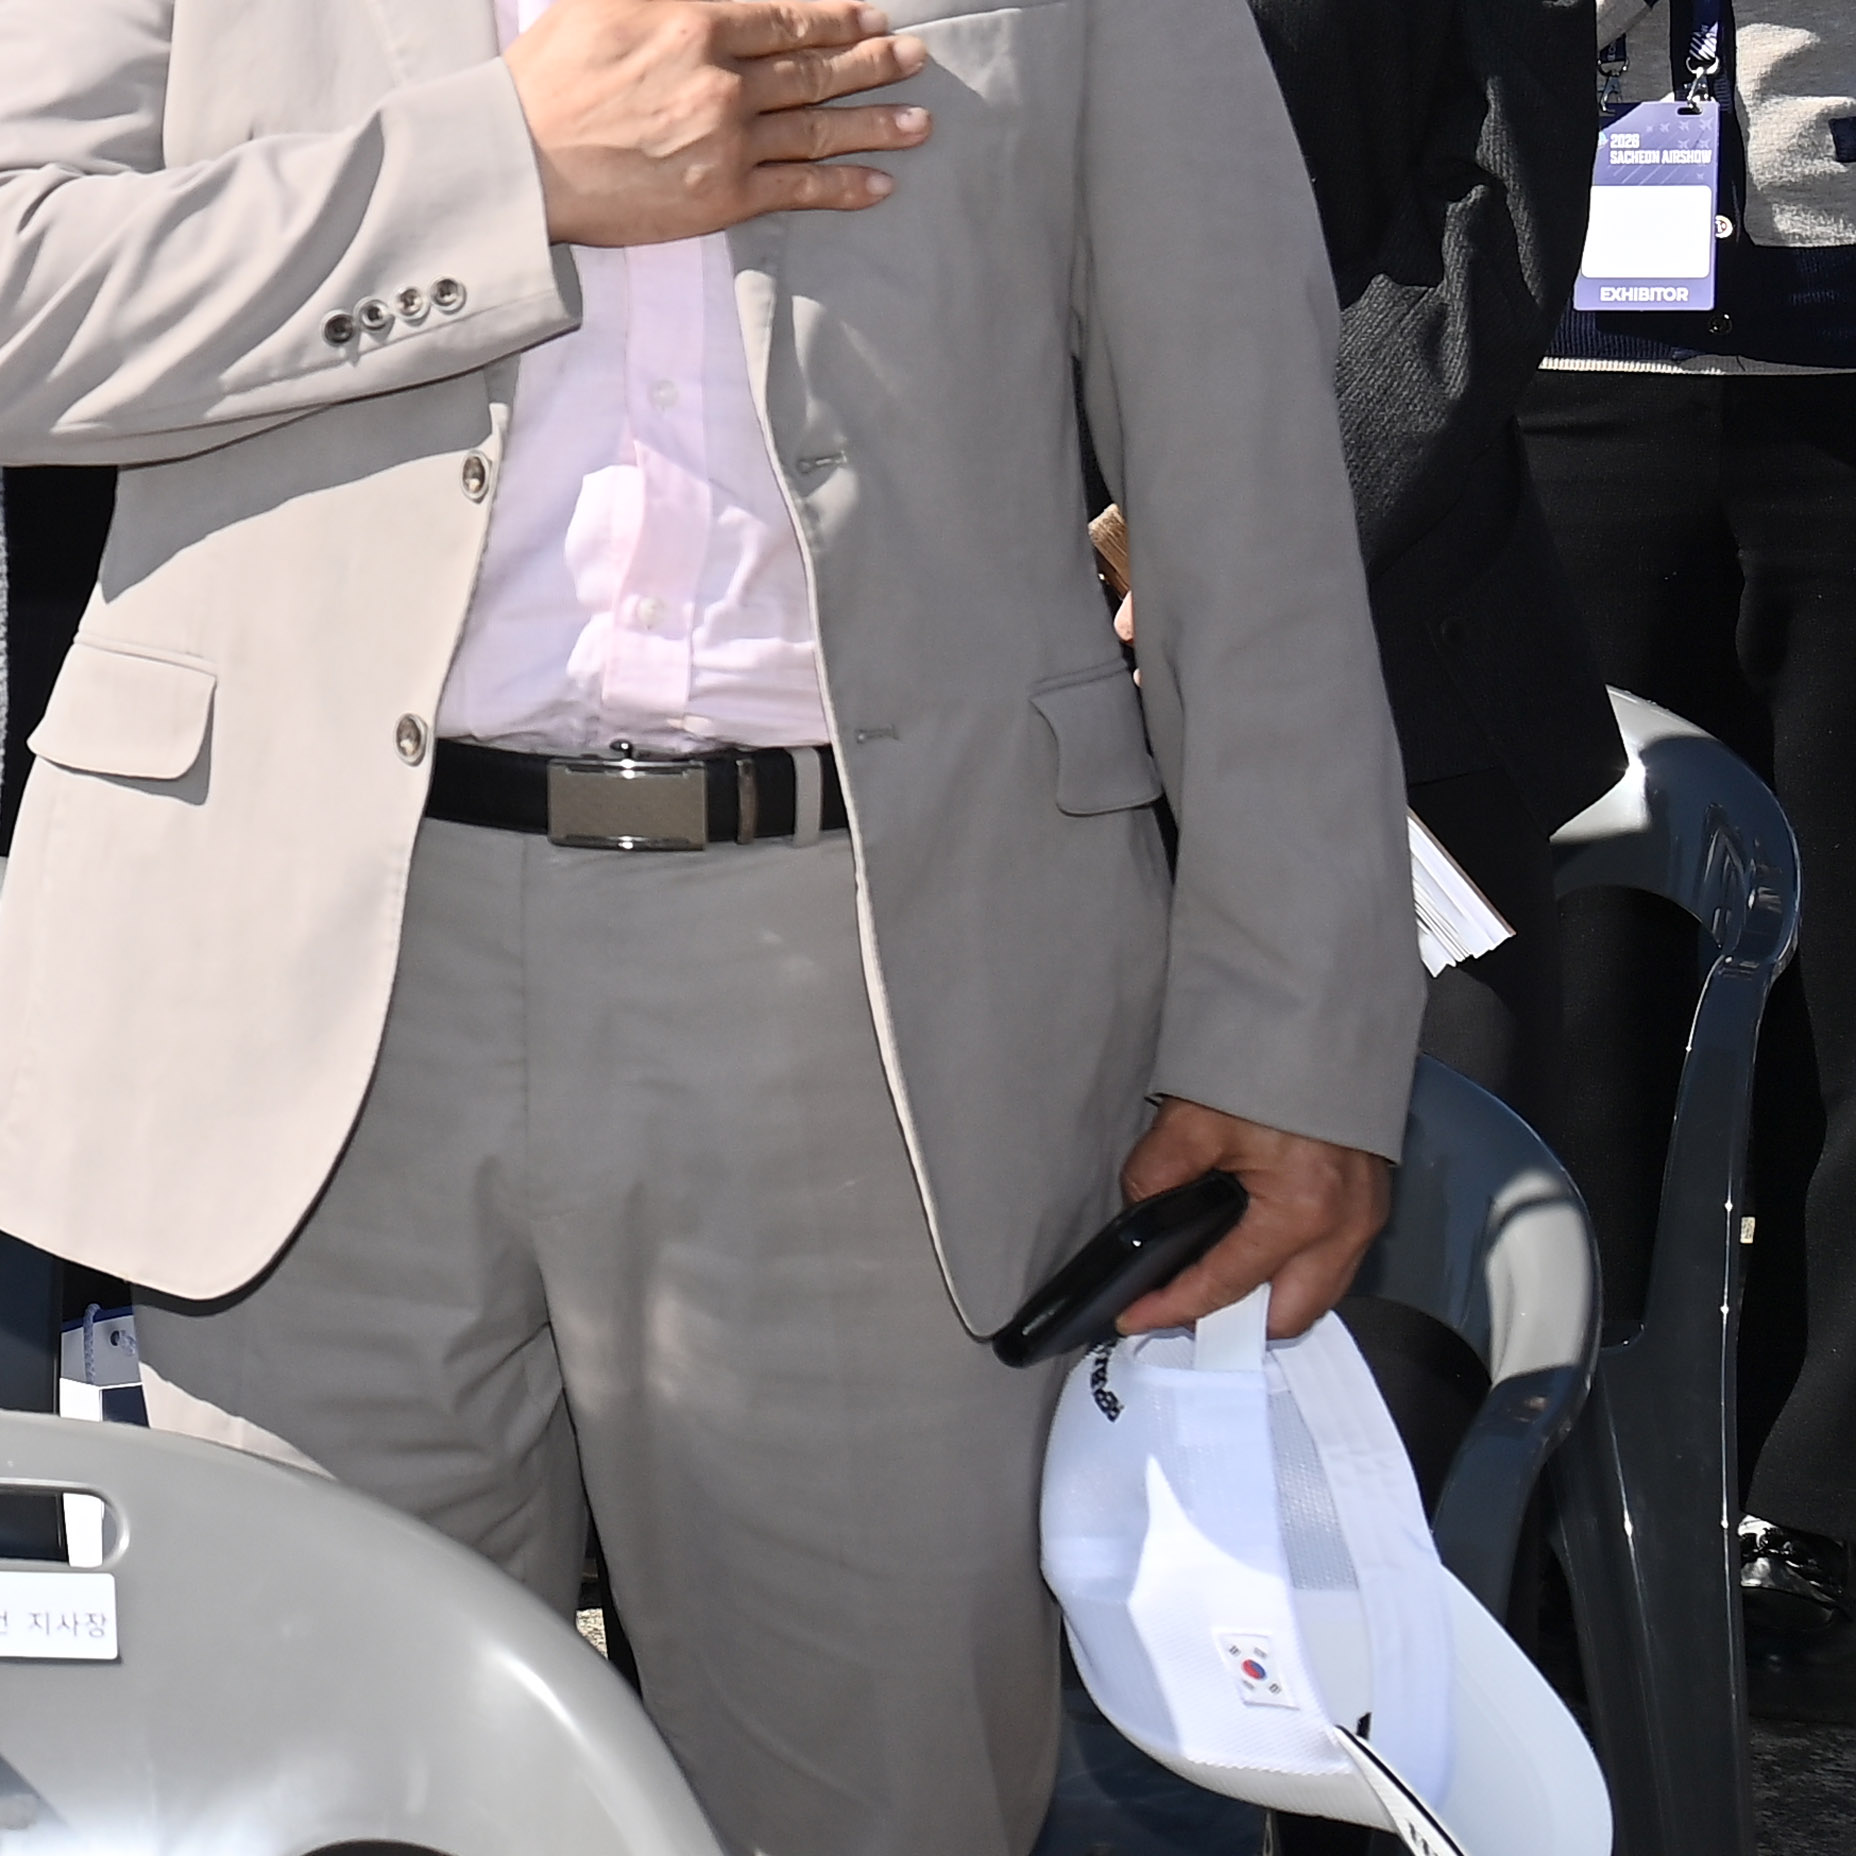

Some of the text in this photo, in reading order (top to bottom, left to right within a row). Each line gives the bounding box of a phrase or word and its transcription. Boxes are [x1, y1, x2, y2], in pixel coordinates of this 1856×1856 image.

[1610, 149, 1712, 165] SACHEON AIRSHOW
[1600, 287, 1689, 302] EXHIBITOR
[30, 1611, 108, 1638] 지사장
